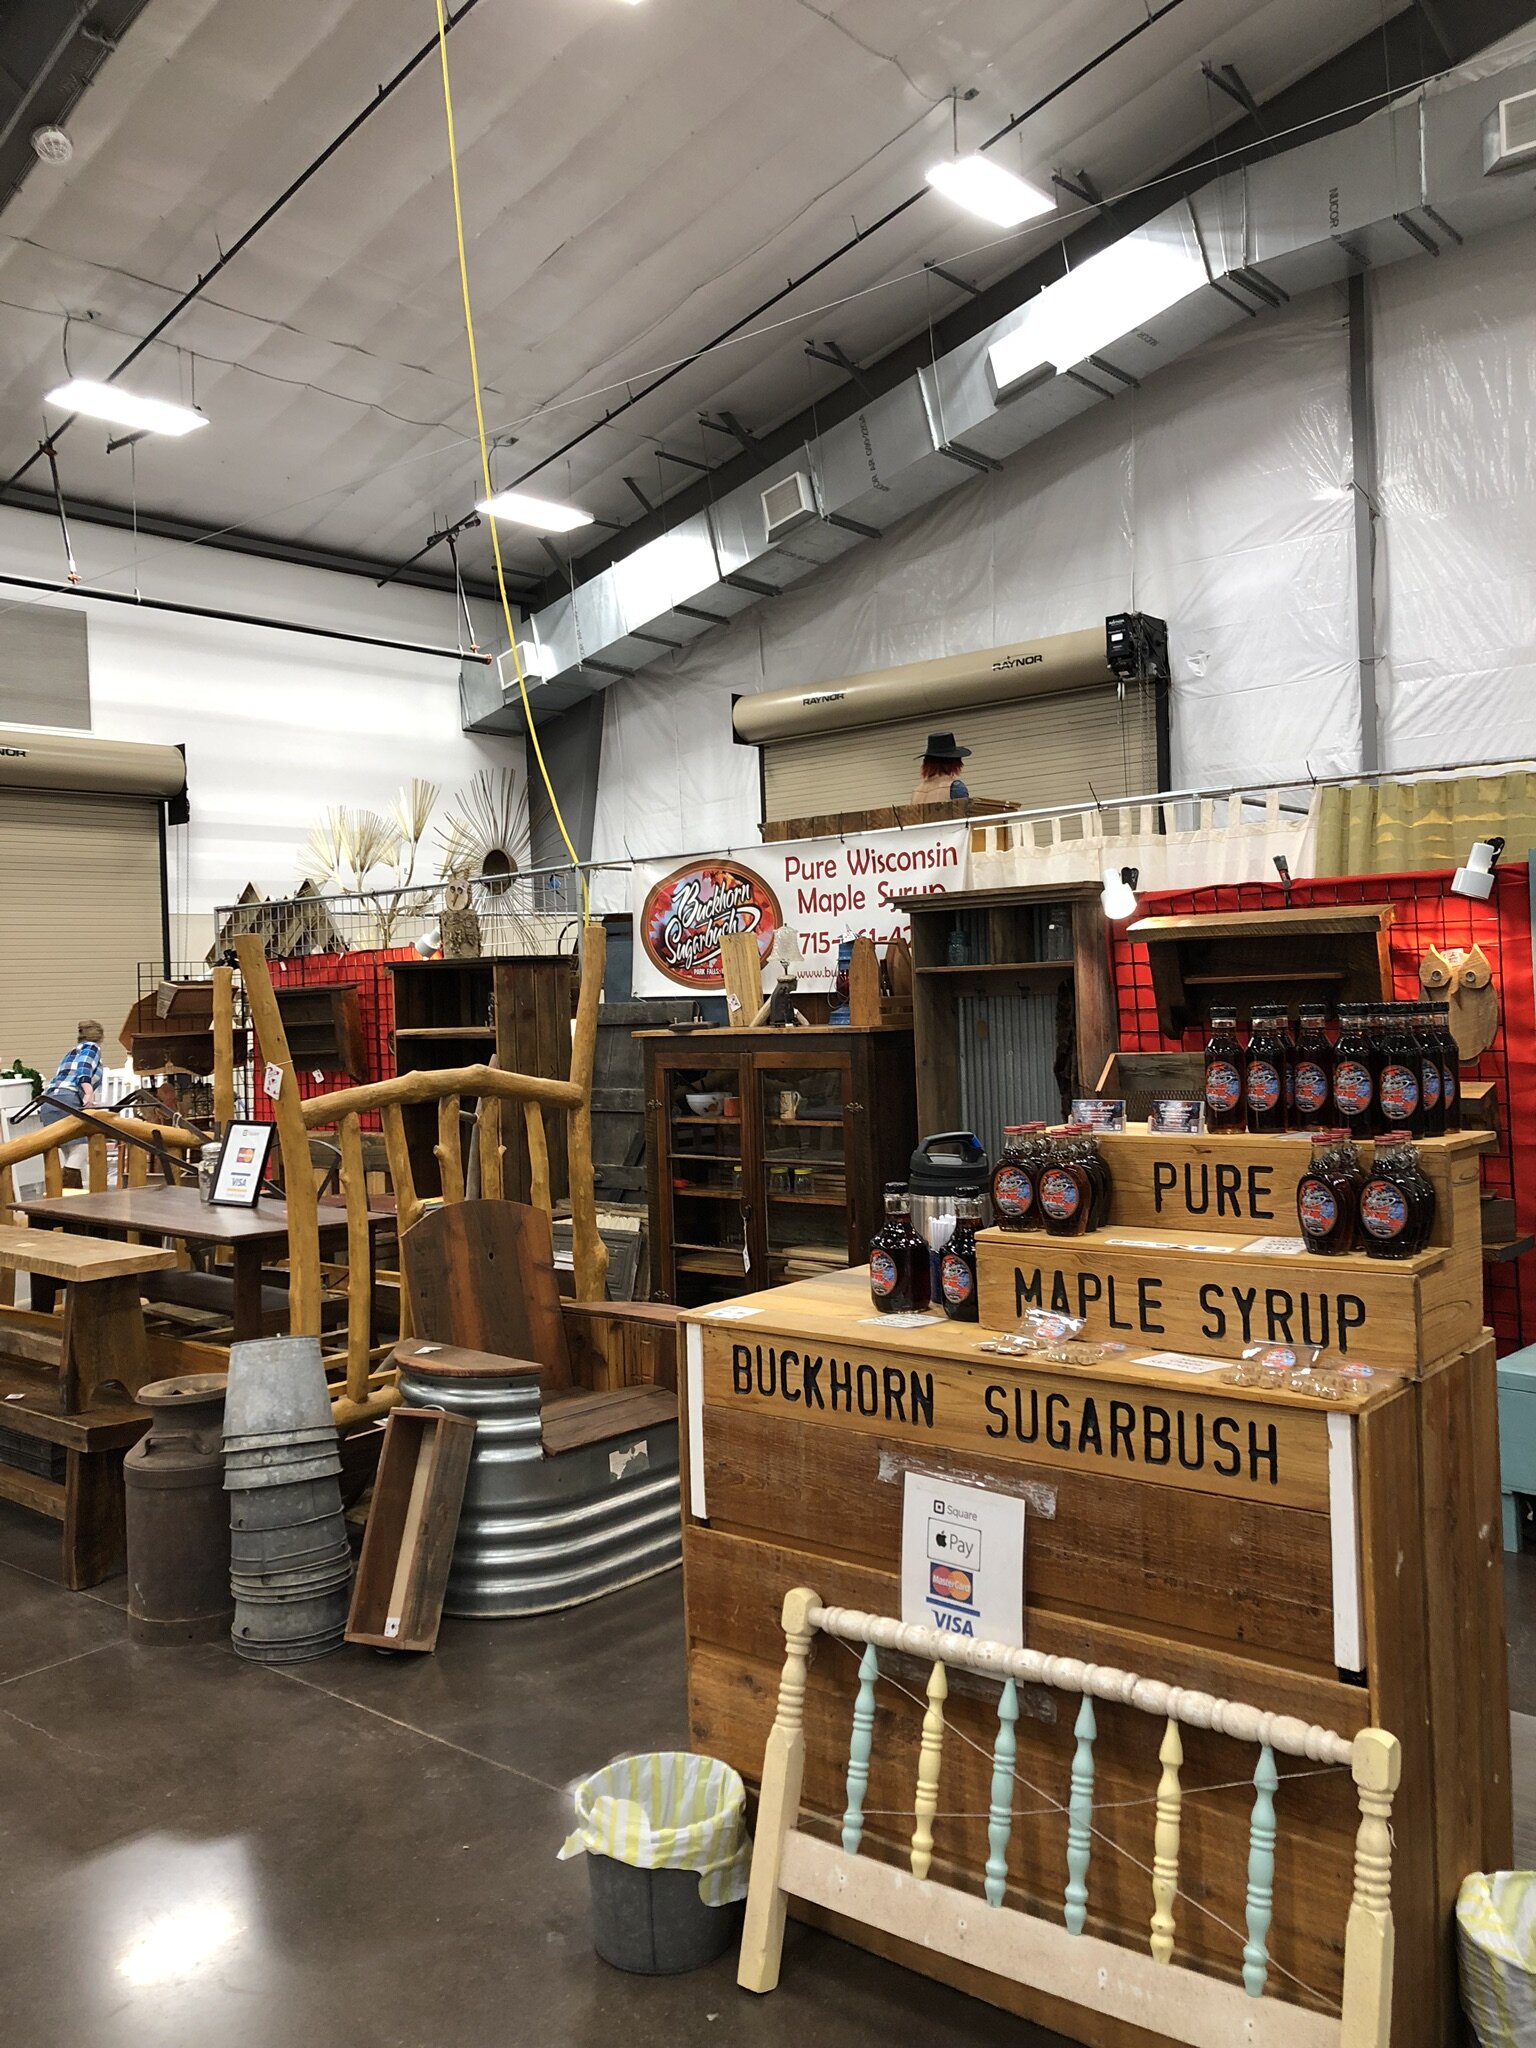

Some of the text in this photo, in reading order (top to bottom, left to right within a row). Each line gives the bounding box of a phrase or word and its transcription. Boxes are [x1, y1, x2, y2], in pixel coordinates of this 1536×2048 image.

[993, 655, 1043, 671] RAYNOR
[803, 693, 845, 706] RAYNOR
[785, 842, 958, 882] Pure Wisconsin
[672, 881, 750, 928] Buckhorn
[798, 884, 866, 917] Maple
[232, 1178, 246, 1186] VISA
[1154, 1160, 1274, 1220] PURE
[1014, 1267, 1166, 1334] MAPLE
[1200, 1283, 1366, 1355] SYRUP
[732, 1343, 1279, 1487] BUCKHORN SUGARBUSH
[946, 1504, 978, 1522] Square
[949, 1533, 974, 1559] Pay
[932, 1574, 972, 1594] MasterCard
[932, 1609, 975, 1638] VISA
